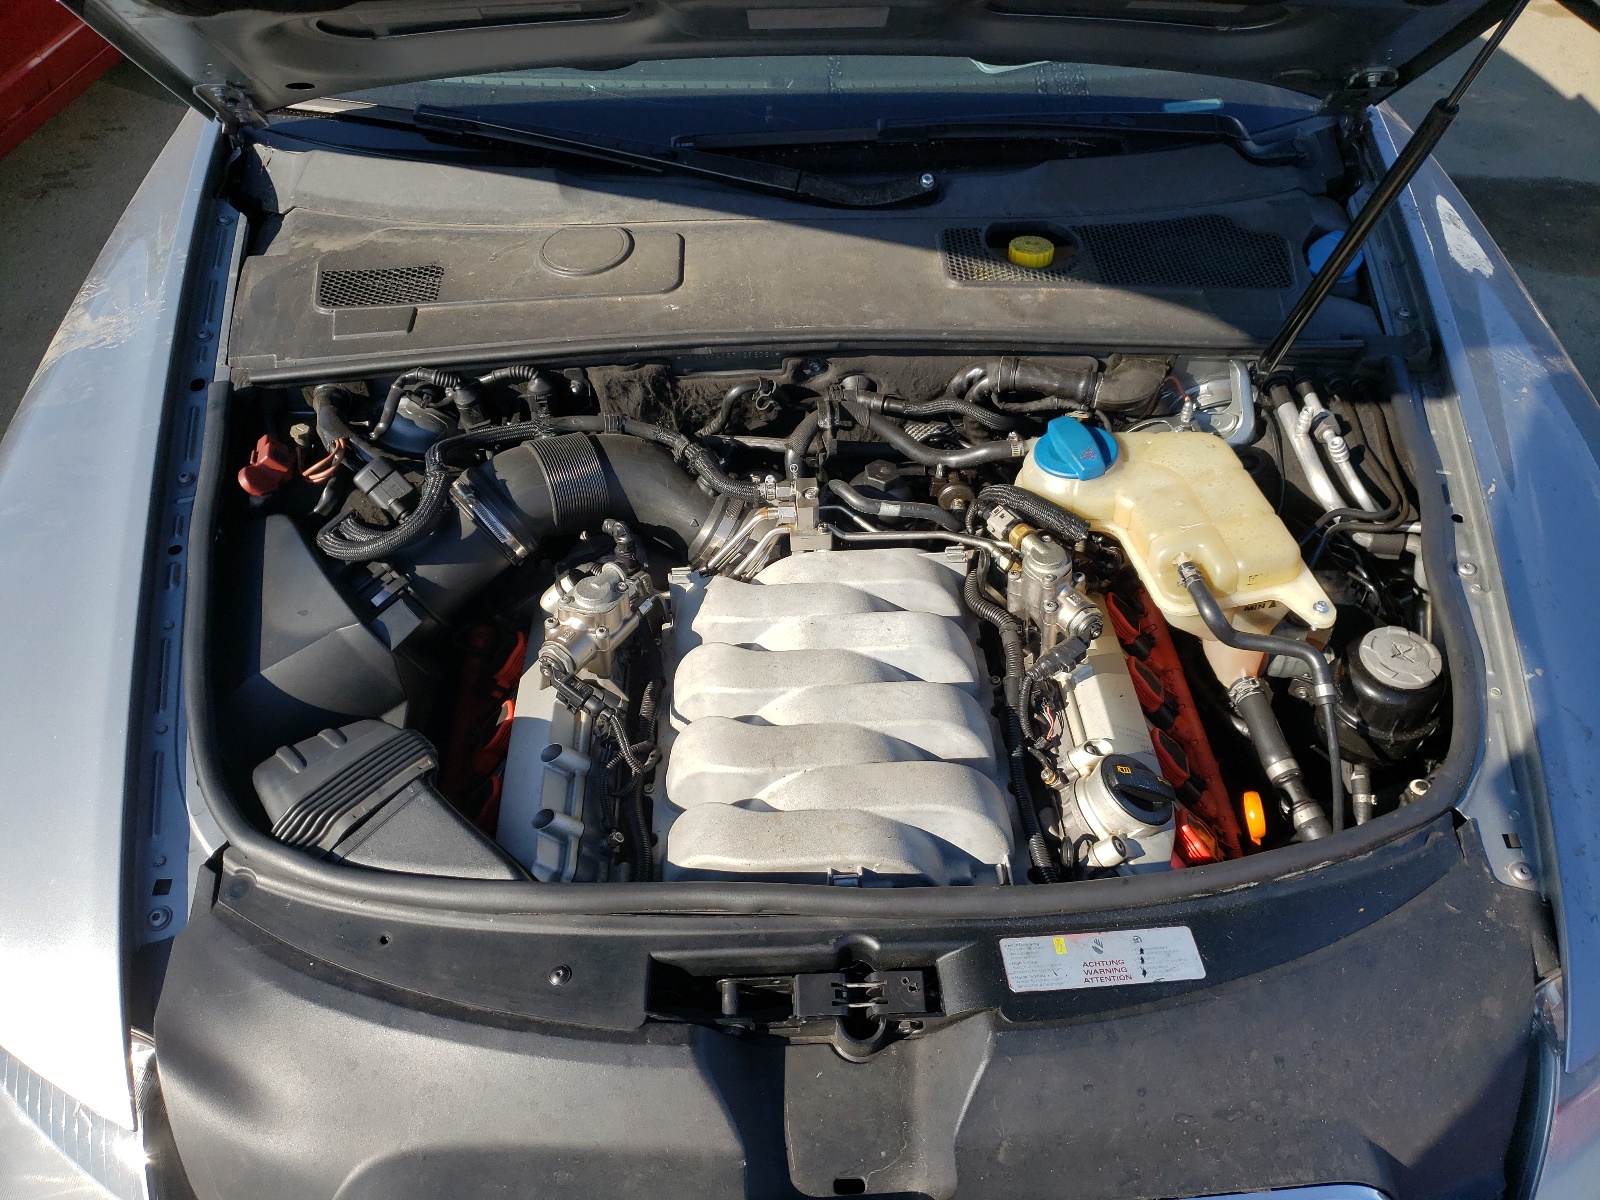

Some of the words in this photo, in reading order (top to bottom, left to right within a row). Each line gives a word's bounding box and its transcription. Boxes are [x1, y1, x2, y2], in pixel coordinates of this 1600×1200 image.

[1244, 603, 1265, 611] MIN
[1083, 967, 1127, 975] WARNING
[1084, 974, 1132, 983] ATTENTION
